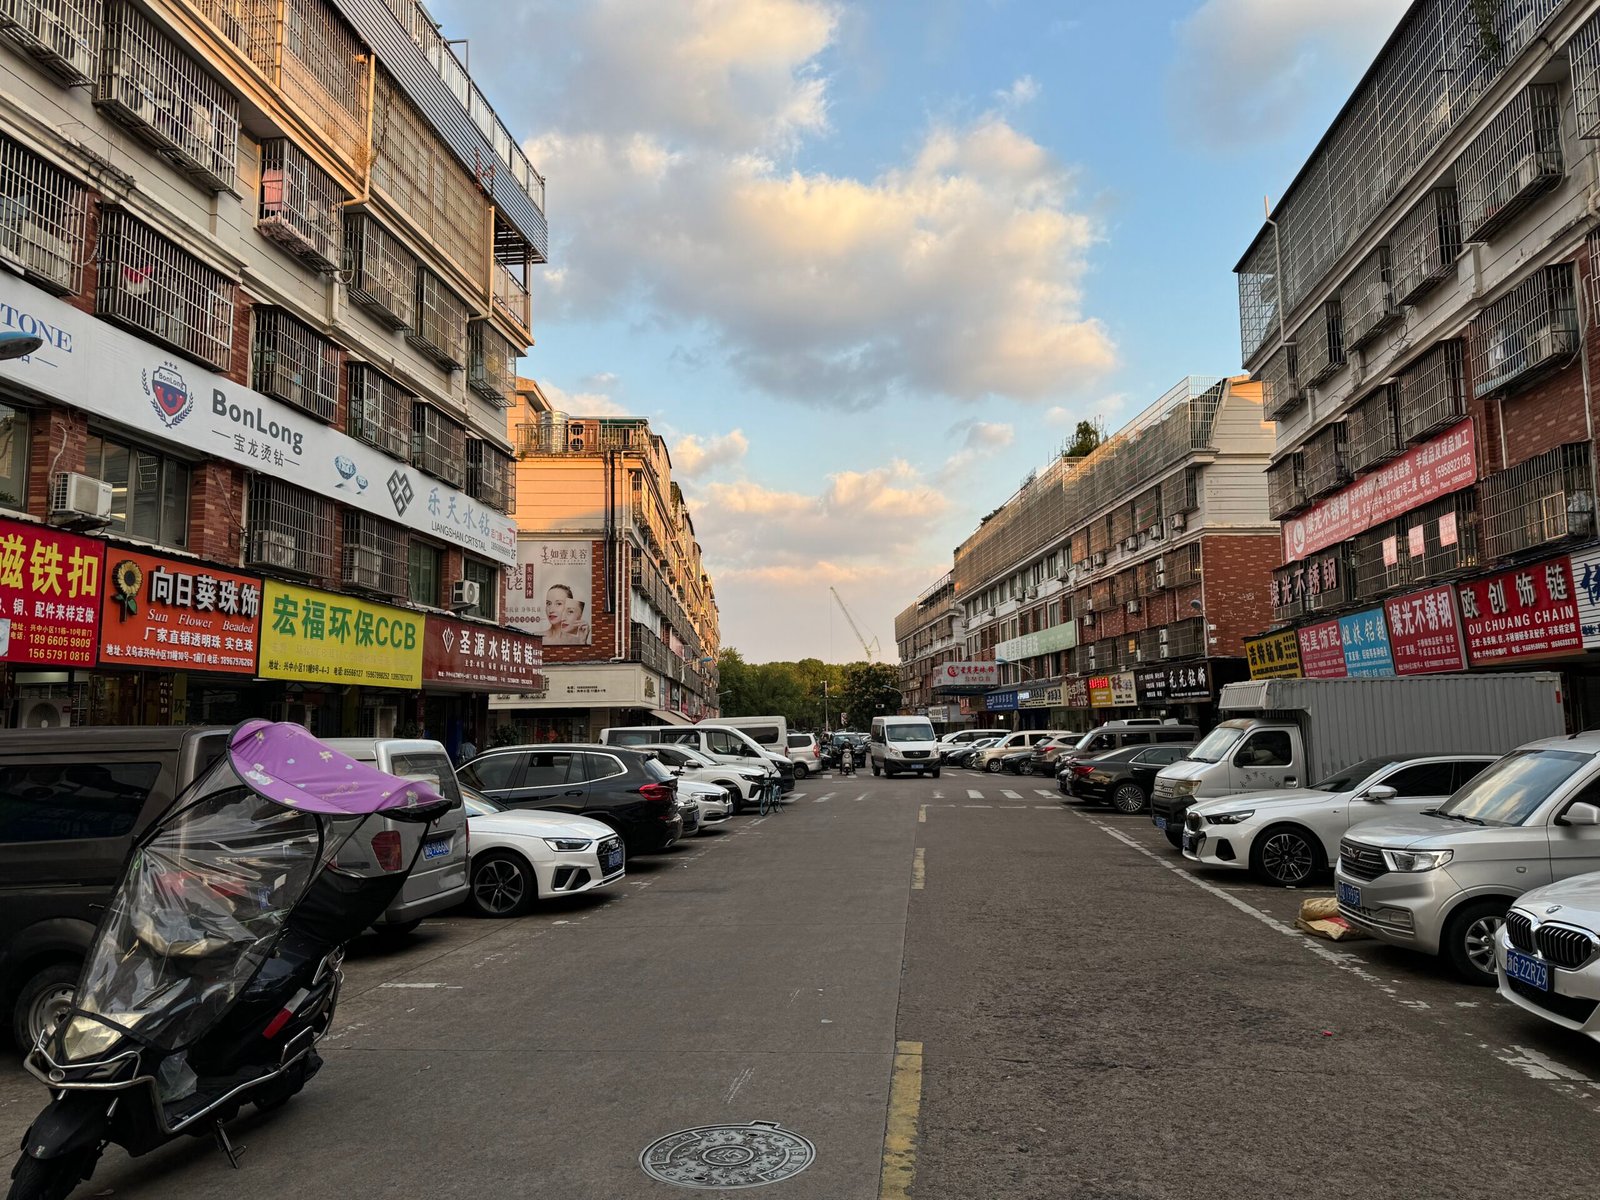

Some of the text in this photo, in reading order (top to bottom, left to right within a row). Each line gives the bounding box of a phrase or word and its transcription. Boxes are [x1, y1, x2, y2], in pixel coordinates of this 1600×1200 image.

[212, 388, 304, 456] BonLong
[233, 433, 285, 468] 宝龙烫钻
[428, 487, 490, 537] 乐天水钻
[151, 565, 260, 618] 向日葵珠饰
[1459, 563, 1568, 619] 欧创饰链
[148, 608, 254, 633] Sun Flower Beaded
[272, 594, 416, 650] 宏福环保CCB
[1468, 605, 1574, 635] OU CHUANG CHAIN
[28, 648, 90, 662] 156 5791 0816
[29, 634, 45, 645] 189
[47, 635, 69, 646] 6605
[70, 637, 91, 648] 9809
[225, 637, 253, 652] 实色珠
[459, 630, 533, 665] 圣源水钻钻链
